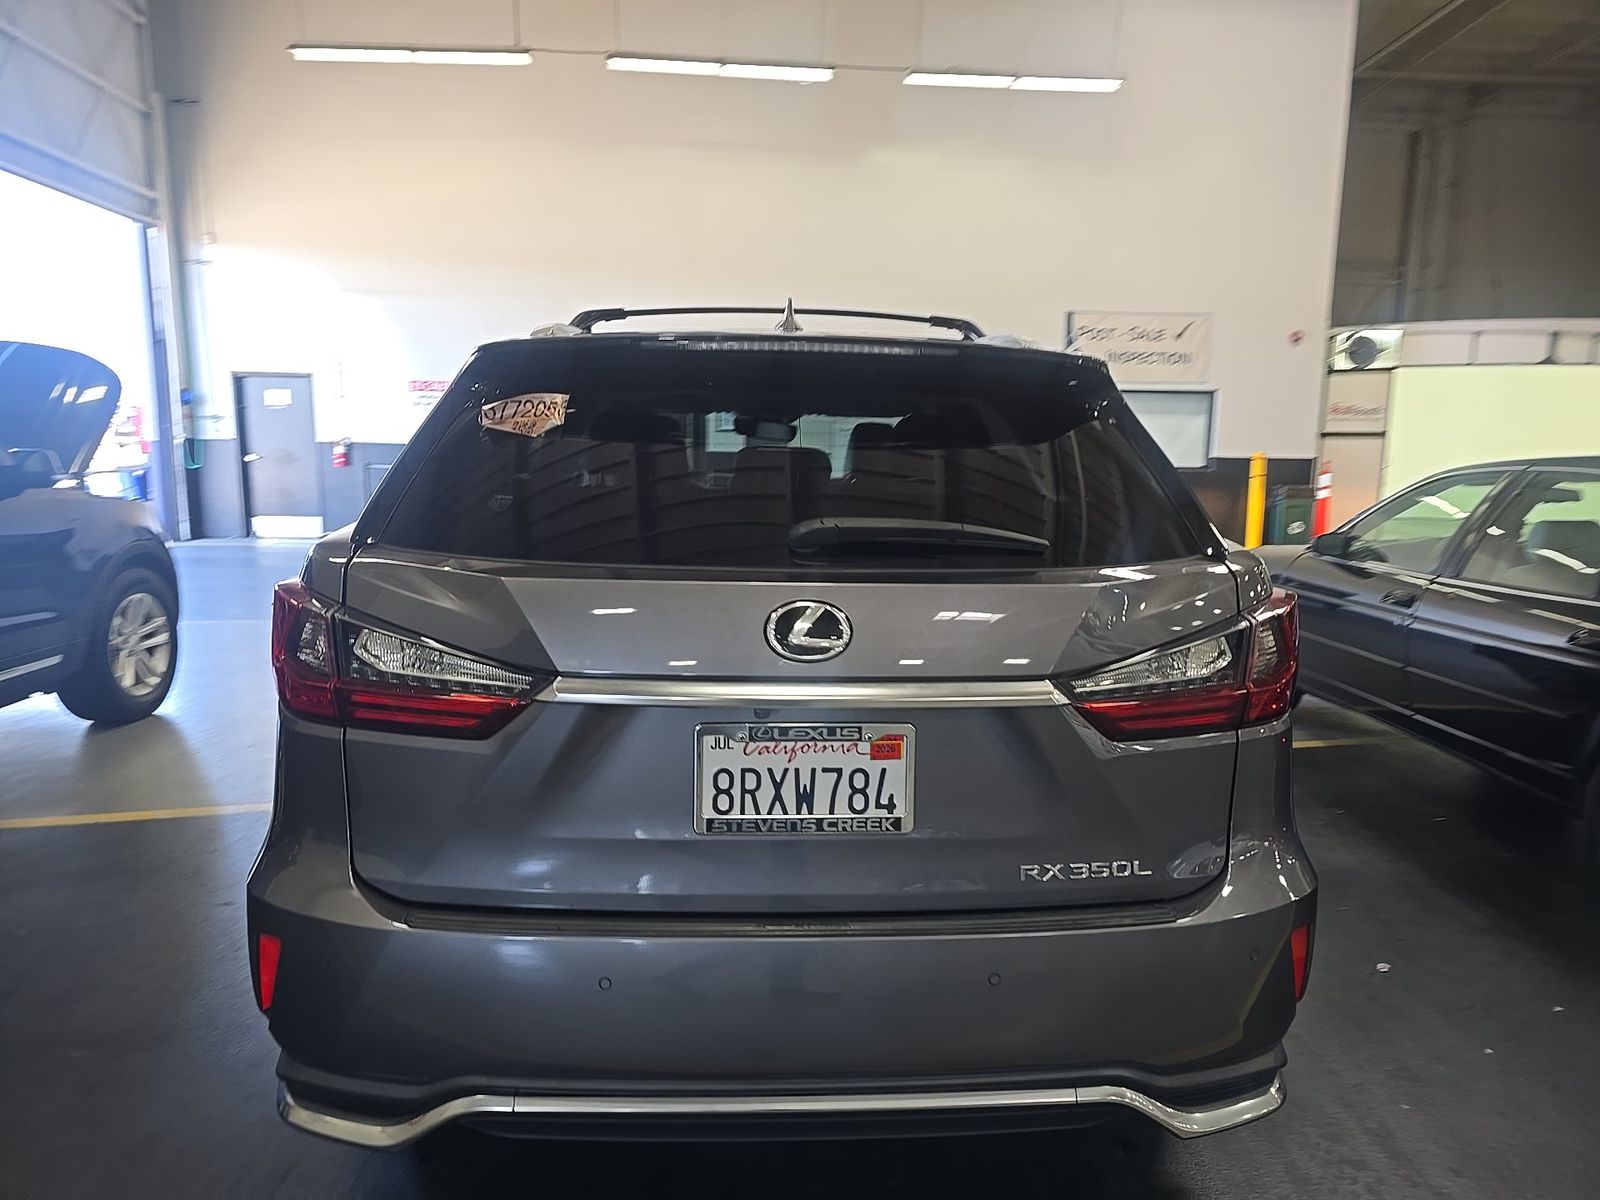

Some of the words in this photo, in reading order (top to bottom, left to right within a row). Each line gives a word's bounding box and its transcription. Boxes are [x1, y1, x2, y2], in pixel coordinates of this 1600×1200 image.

[774, 727, 859, 740] LEXUS
[710, 736, 734, 750] JUL
[741, 738, 870, 763] California
[712, 767, 897, 815] 8RXW784
[712, 819, 816, 832] STEVENS
[823, 819, 895, 831] CREEK
